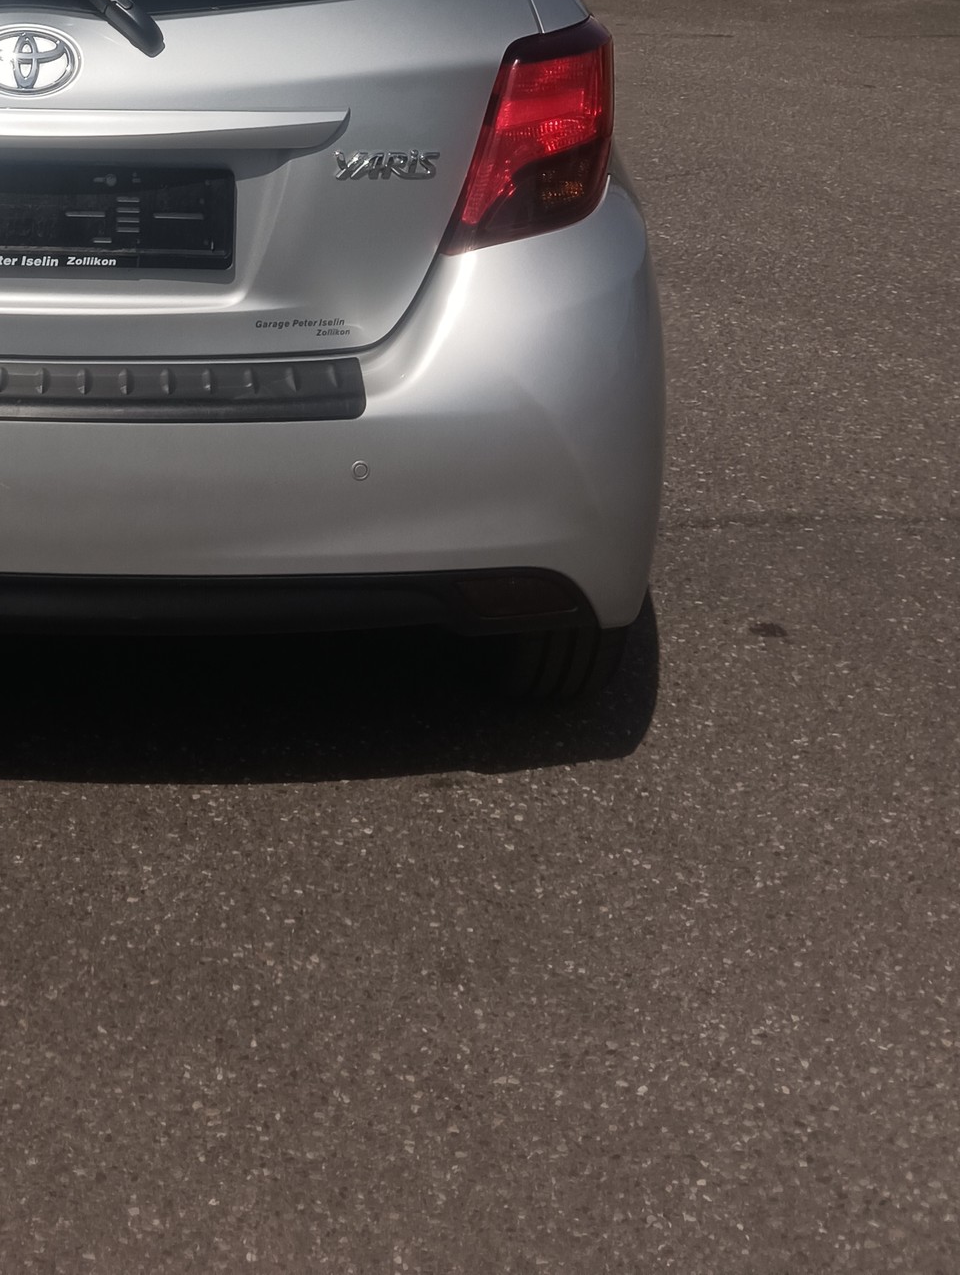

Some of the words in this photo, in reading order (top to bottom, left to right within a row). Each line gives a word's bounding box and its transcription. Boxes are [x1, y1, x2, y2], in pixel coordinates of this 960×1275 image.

[334, 148, 441, 180] YARIS
[21, 255, 59, 267] Iselin
[66, 256, 117, 267] Zollikon
[255, 319, 290, 329] Garage
[292, 319, 318, 327] Peter
[319, 318, 345, 327] Iselin
[316, 328, 351, 336] Zollikon
